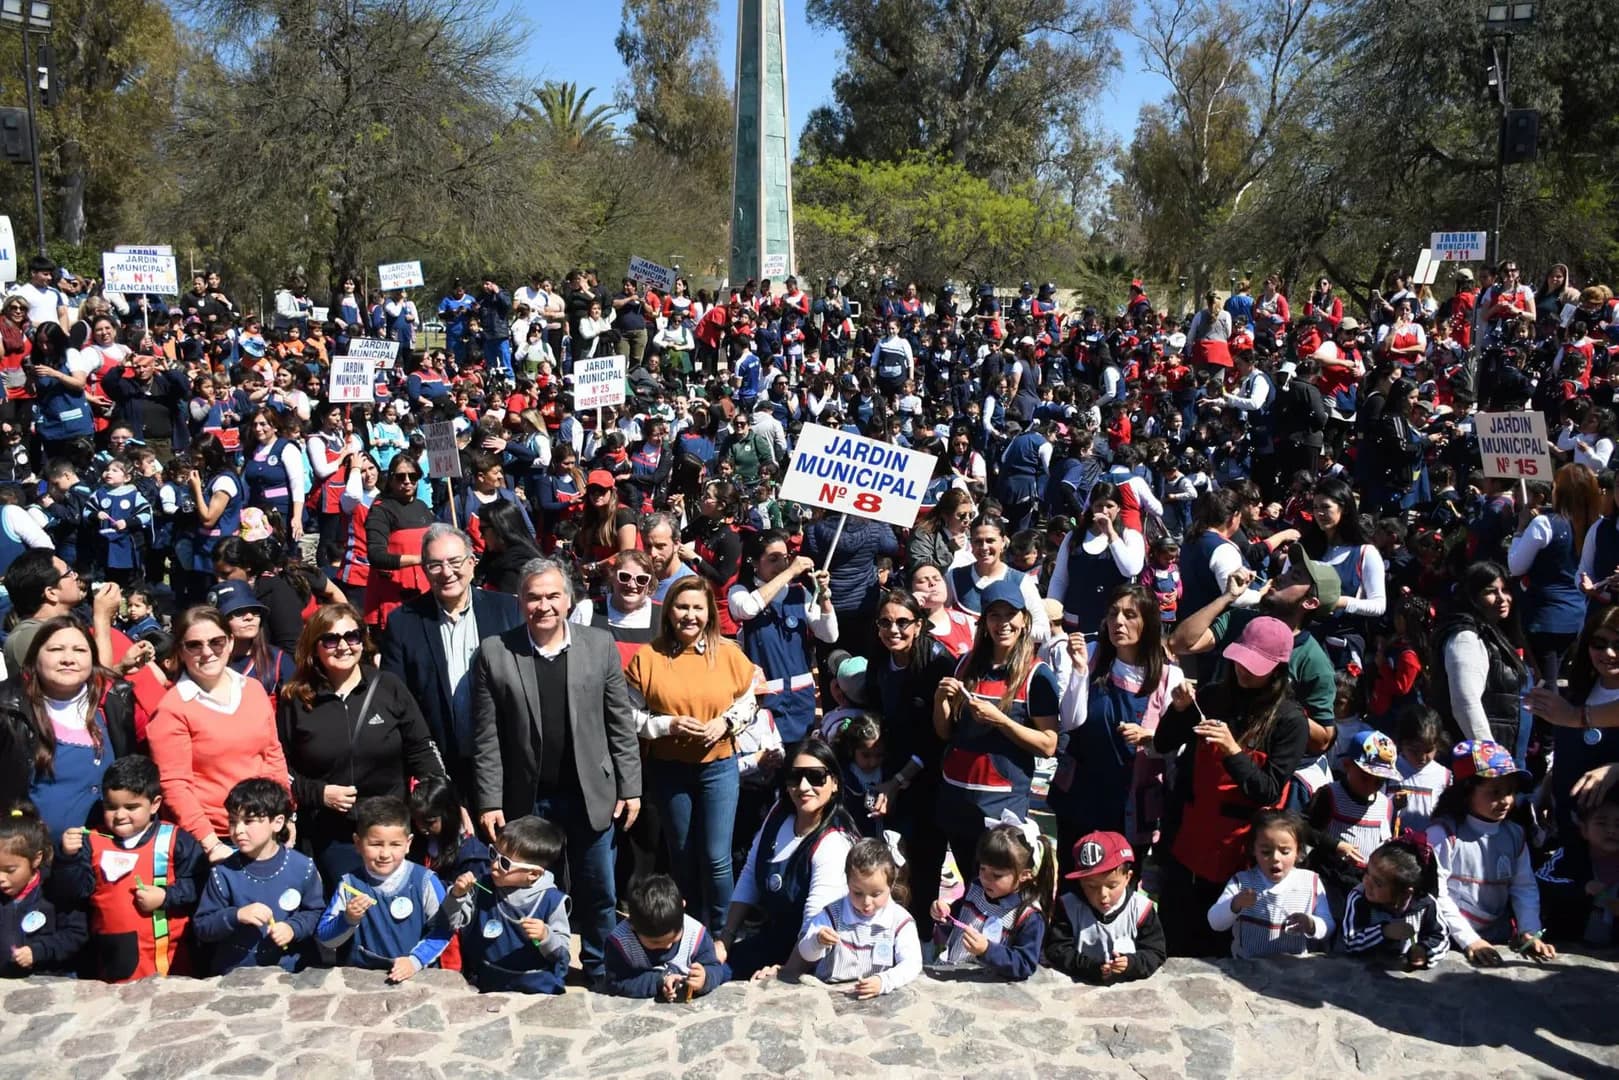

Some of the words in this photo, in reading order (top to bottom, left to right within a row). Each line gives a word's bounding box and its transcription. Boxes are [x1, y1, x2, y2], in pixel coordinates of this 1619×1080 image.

[1440, 233, 1477, 242] JARDIN
[126, 255, 158, 263] JARDIN
[116, 264, 165, 273] MUNICIPAL
[630, 264, 671, 285] MUNICIPAL
[639, 260, 668, 276] JARDIN
[107, 283, 177, 293] BLANCANIEVES
[359, 340, 391, 350] JARDIN
[349, 348, 395, 360] MUNICIPAL
[584, 359, 614, 372] JARDIN
[336, 374, 369, 386] MUNICIPAL
[578, 370, 623, 385] MUNICIPAL
[600, 384, 610, 394] 25
[1489, 416, 1533, 435] JARDIN
[1481, 437, 1546, 456] MUNICIPAL
[824, 435, 909, 473] JARDIN
[1514, 457, 1538, 476] 15
[795, 452, 918, 500] MUNICIPAL
[852, 492, 883, 513] 8
